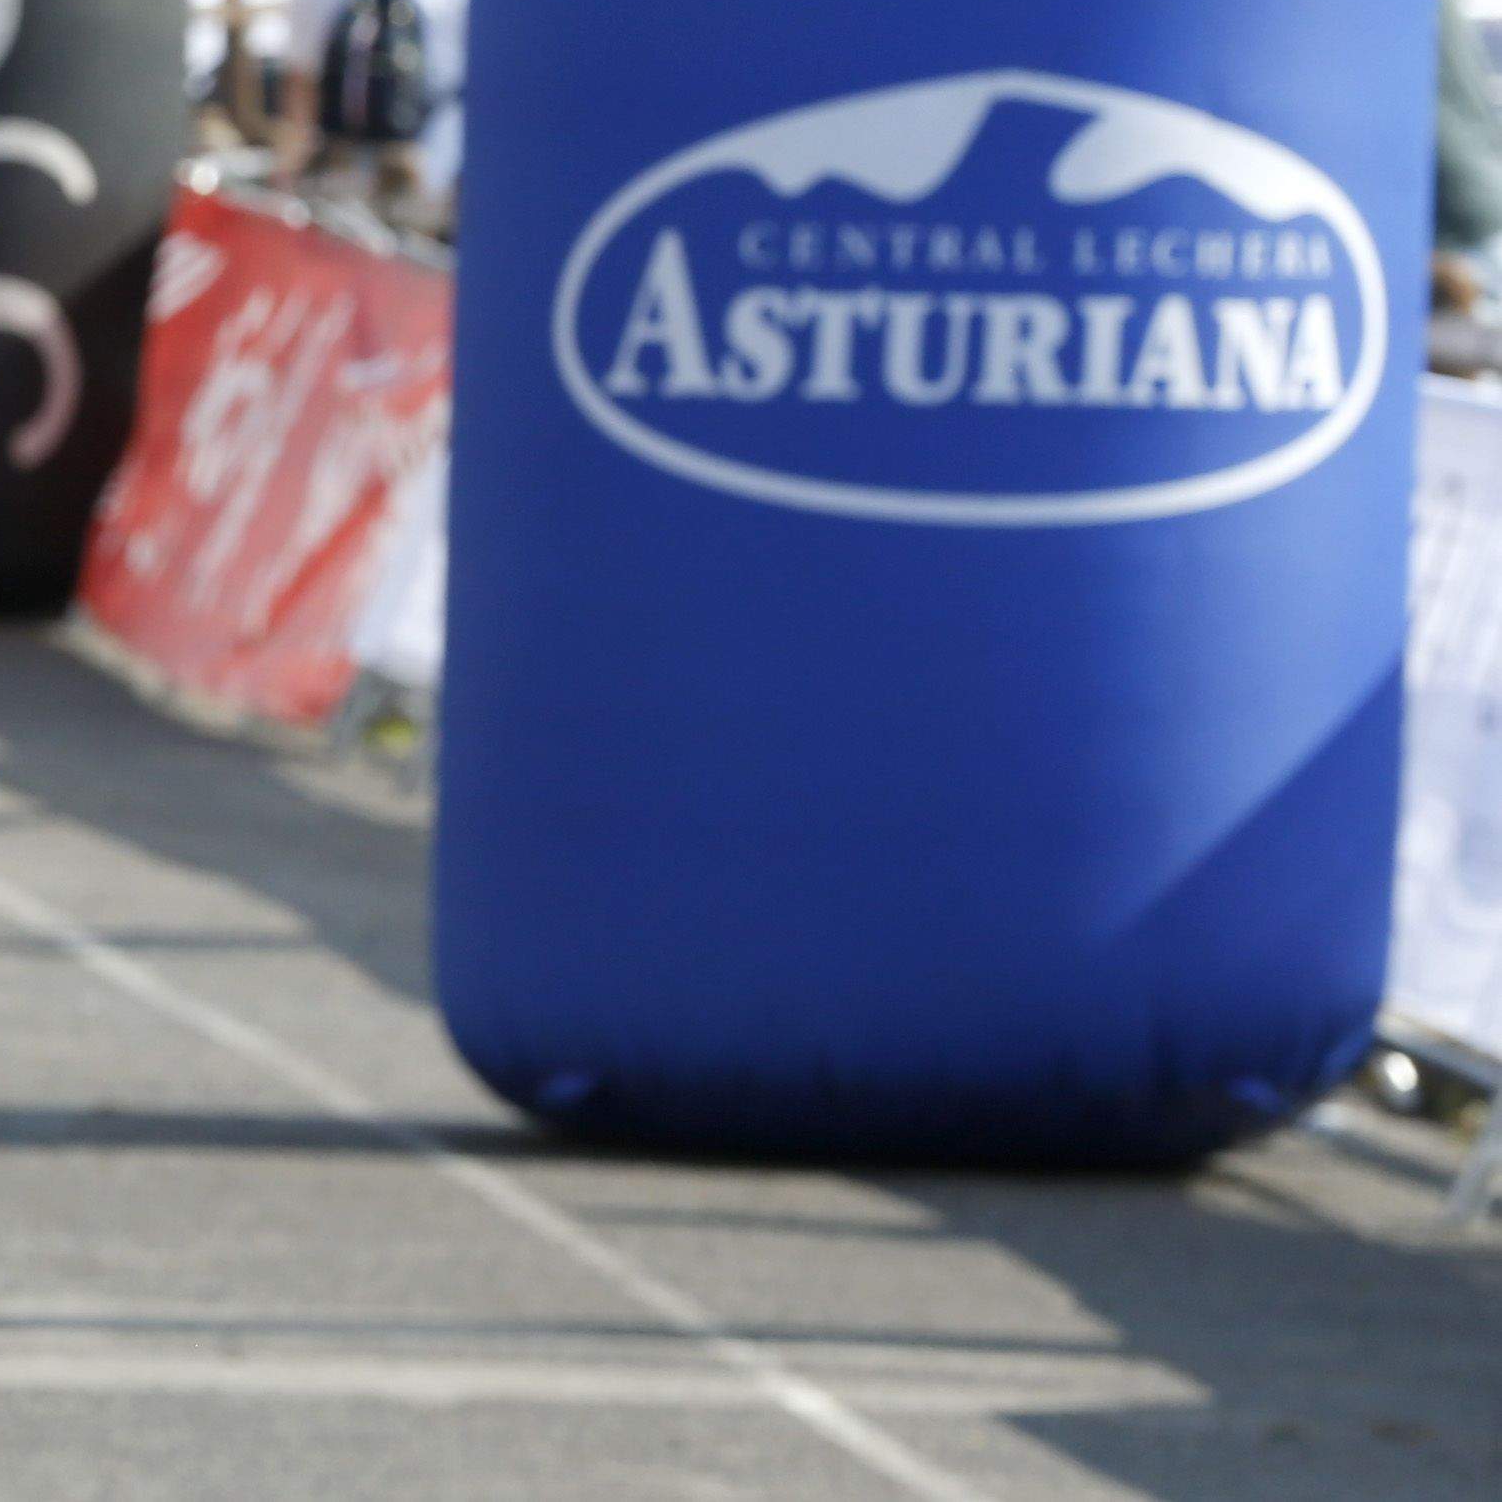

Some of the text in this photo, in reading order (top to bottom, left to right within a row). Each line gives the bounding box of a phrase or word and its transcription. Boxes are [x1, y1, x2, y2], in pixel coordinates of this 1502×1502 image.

[737, 219, 1332, 282] CENTRAL LECHERA
[605, 224, 1345, 412] ASTURIANA
